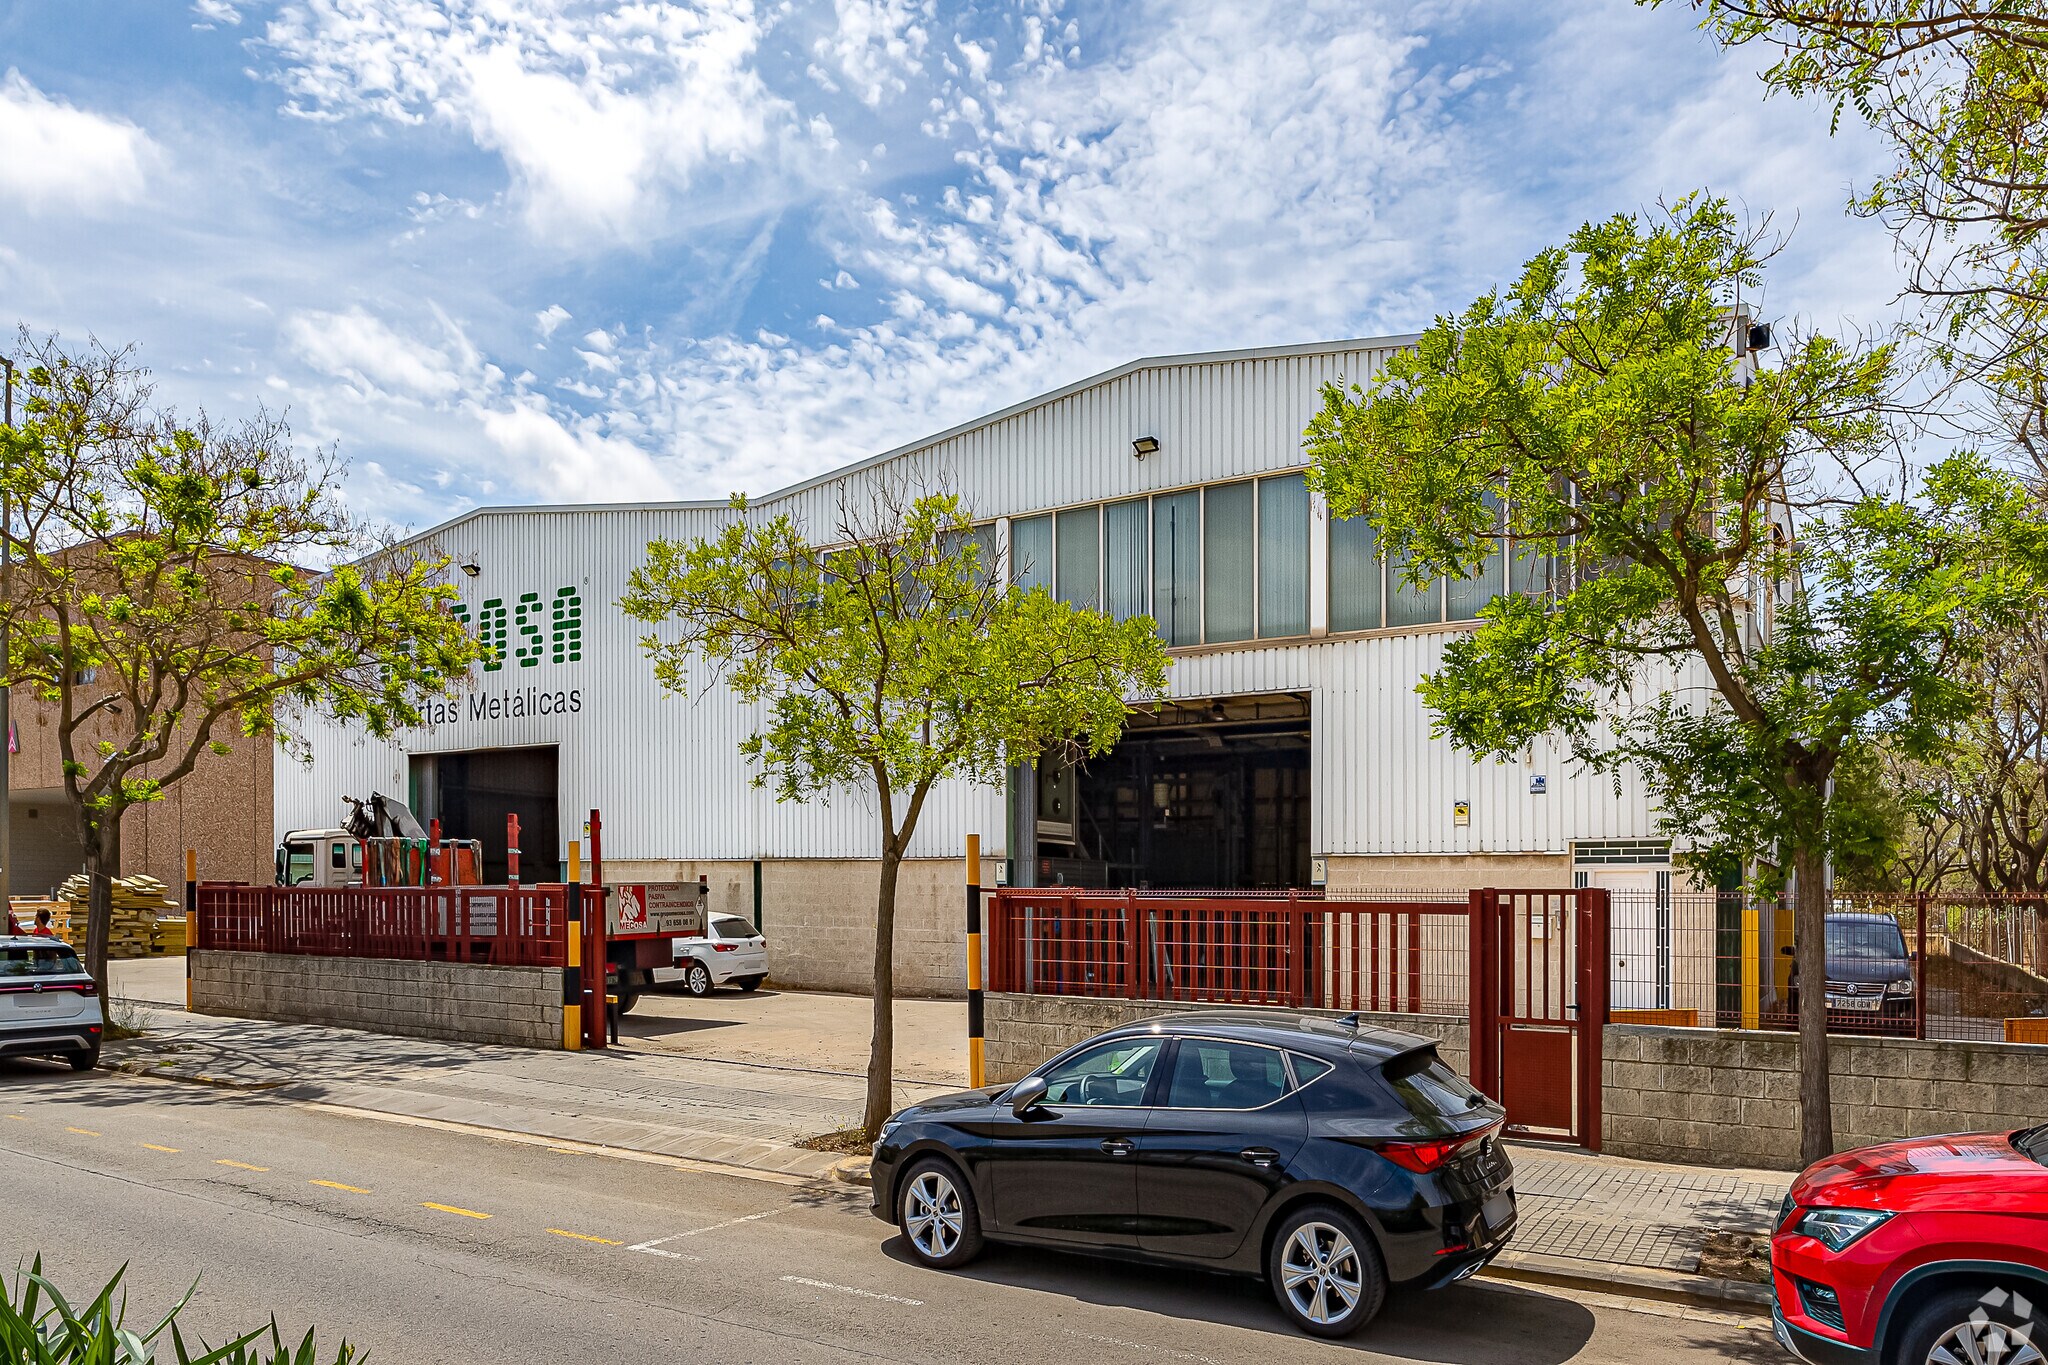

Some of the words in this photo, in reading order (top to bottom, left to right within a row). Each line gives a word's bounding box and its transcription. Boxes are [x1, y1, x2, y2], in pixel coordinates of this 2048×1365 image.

[470, 686, 582, 722] Metálicas
[648, 884, 679, 892] PROTECCIÓN
[620, 921, 647, 930] MECOSA
